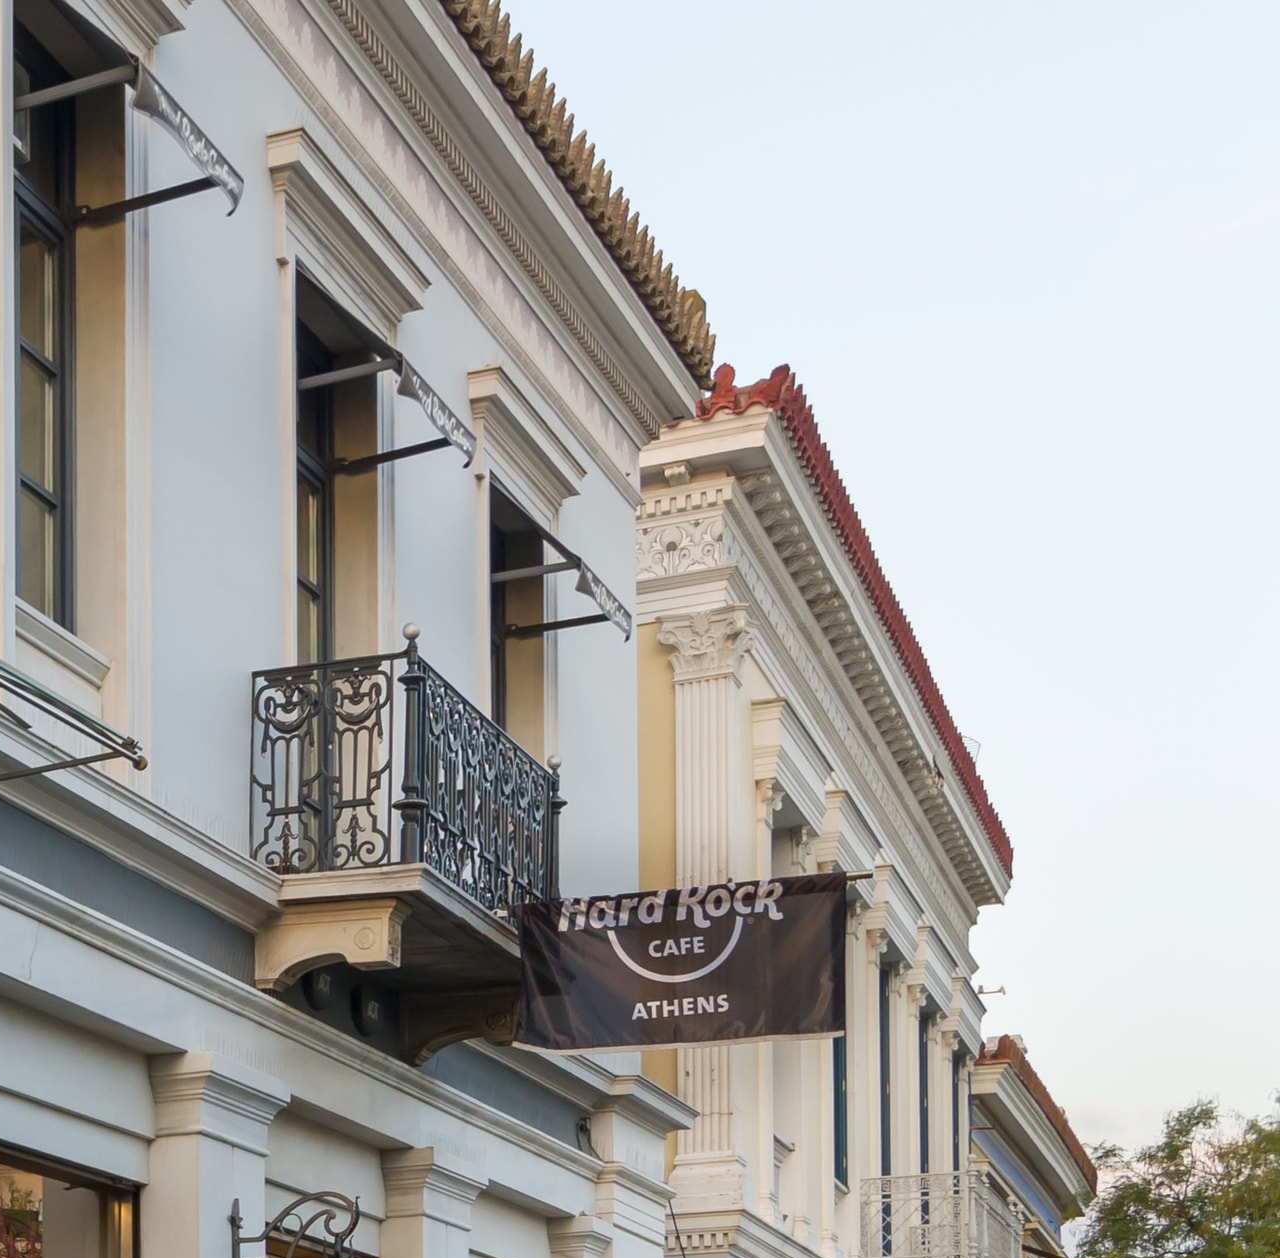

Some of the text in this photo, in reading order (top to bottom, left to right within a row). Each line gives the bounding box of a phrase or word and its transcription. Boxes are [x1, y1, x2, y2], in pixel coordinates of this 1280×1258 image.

[558, 879, 784, 932] Hard Rock
[648, 935, 705, 958] CAFE
[631, 994, 730, 1020] ATHENS
